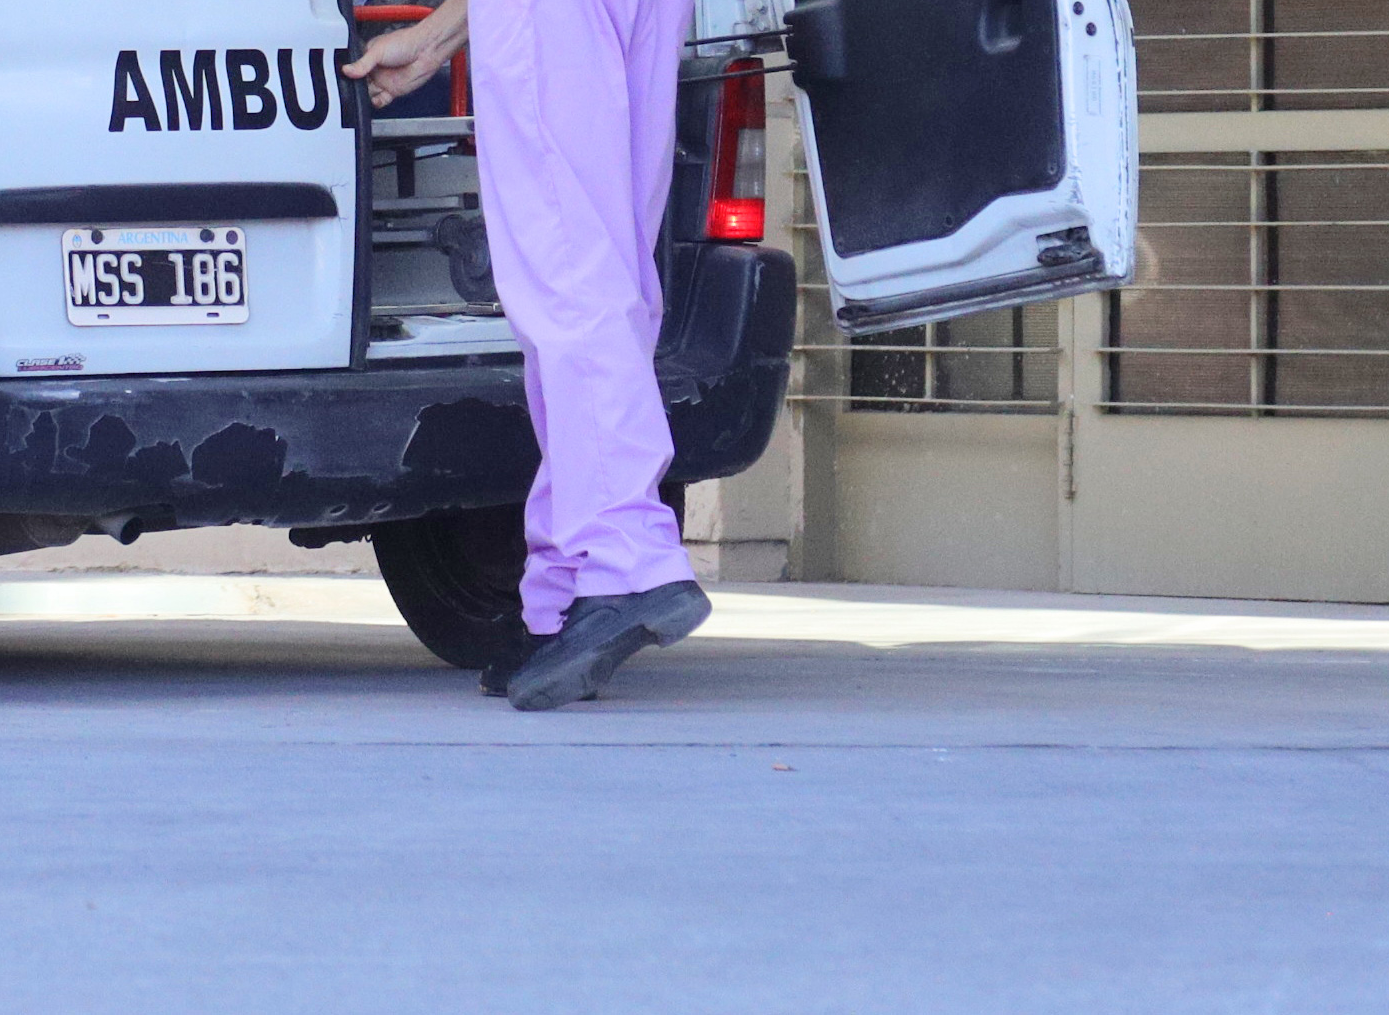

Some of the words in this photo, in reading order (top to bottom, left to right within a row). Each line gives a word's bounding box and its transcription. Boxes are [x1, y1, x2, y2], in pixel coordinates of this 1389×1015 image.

[118, 231, 189, 244] ARGENTINA
[71, 253, 144, 305] MSS
[168, 253, 241, 304] 186
